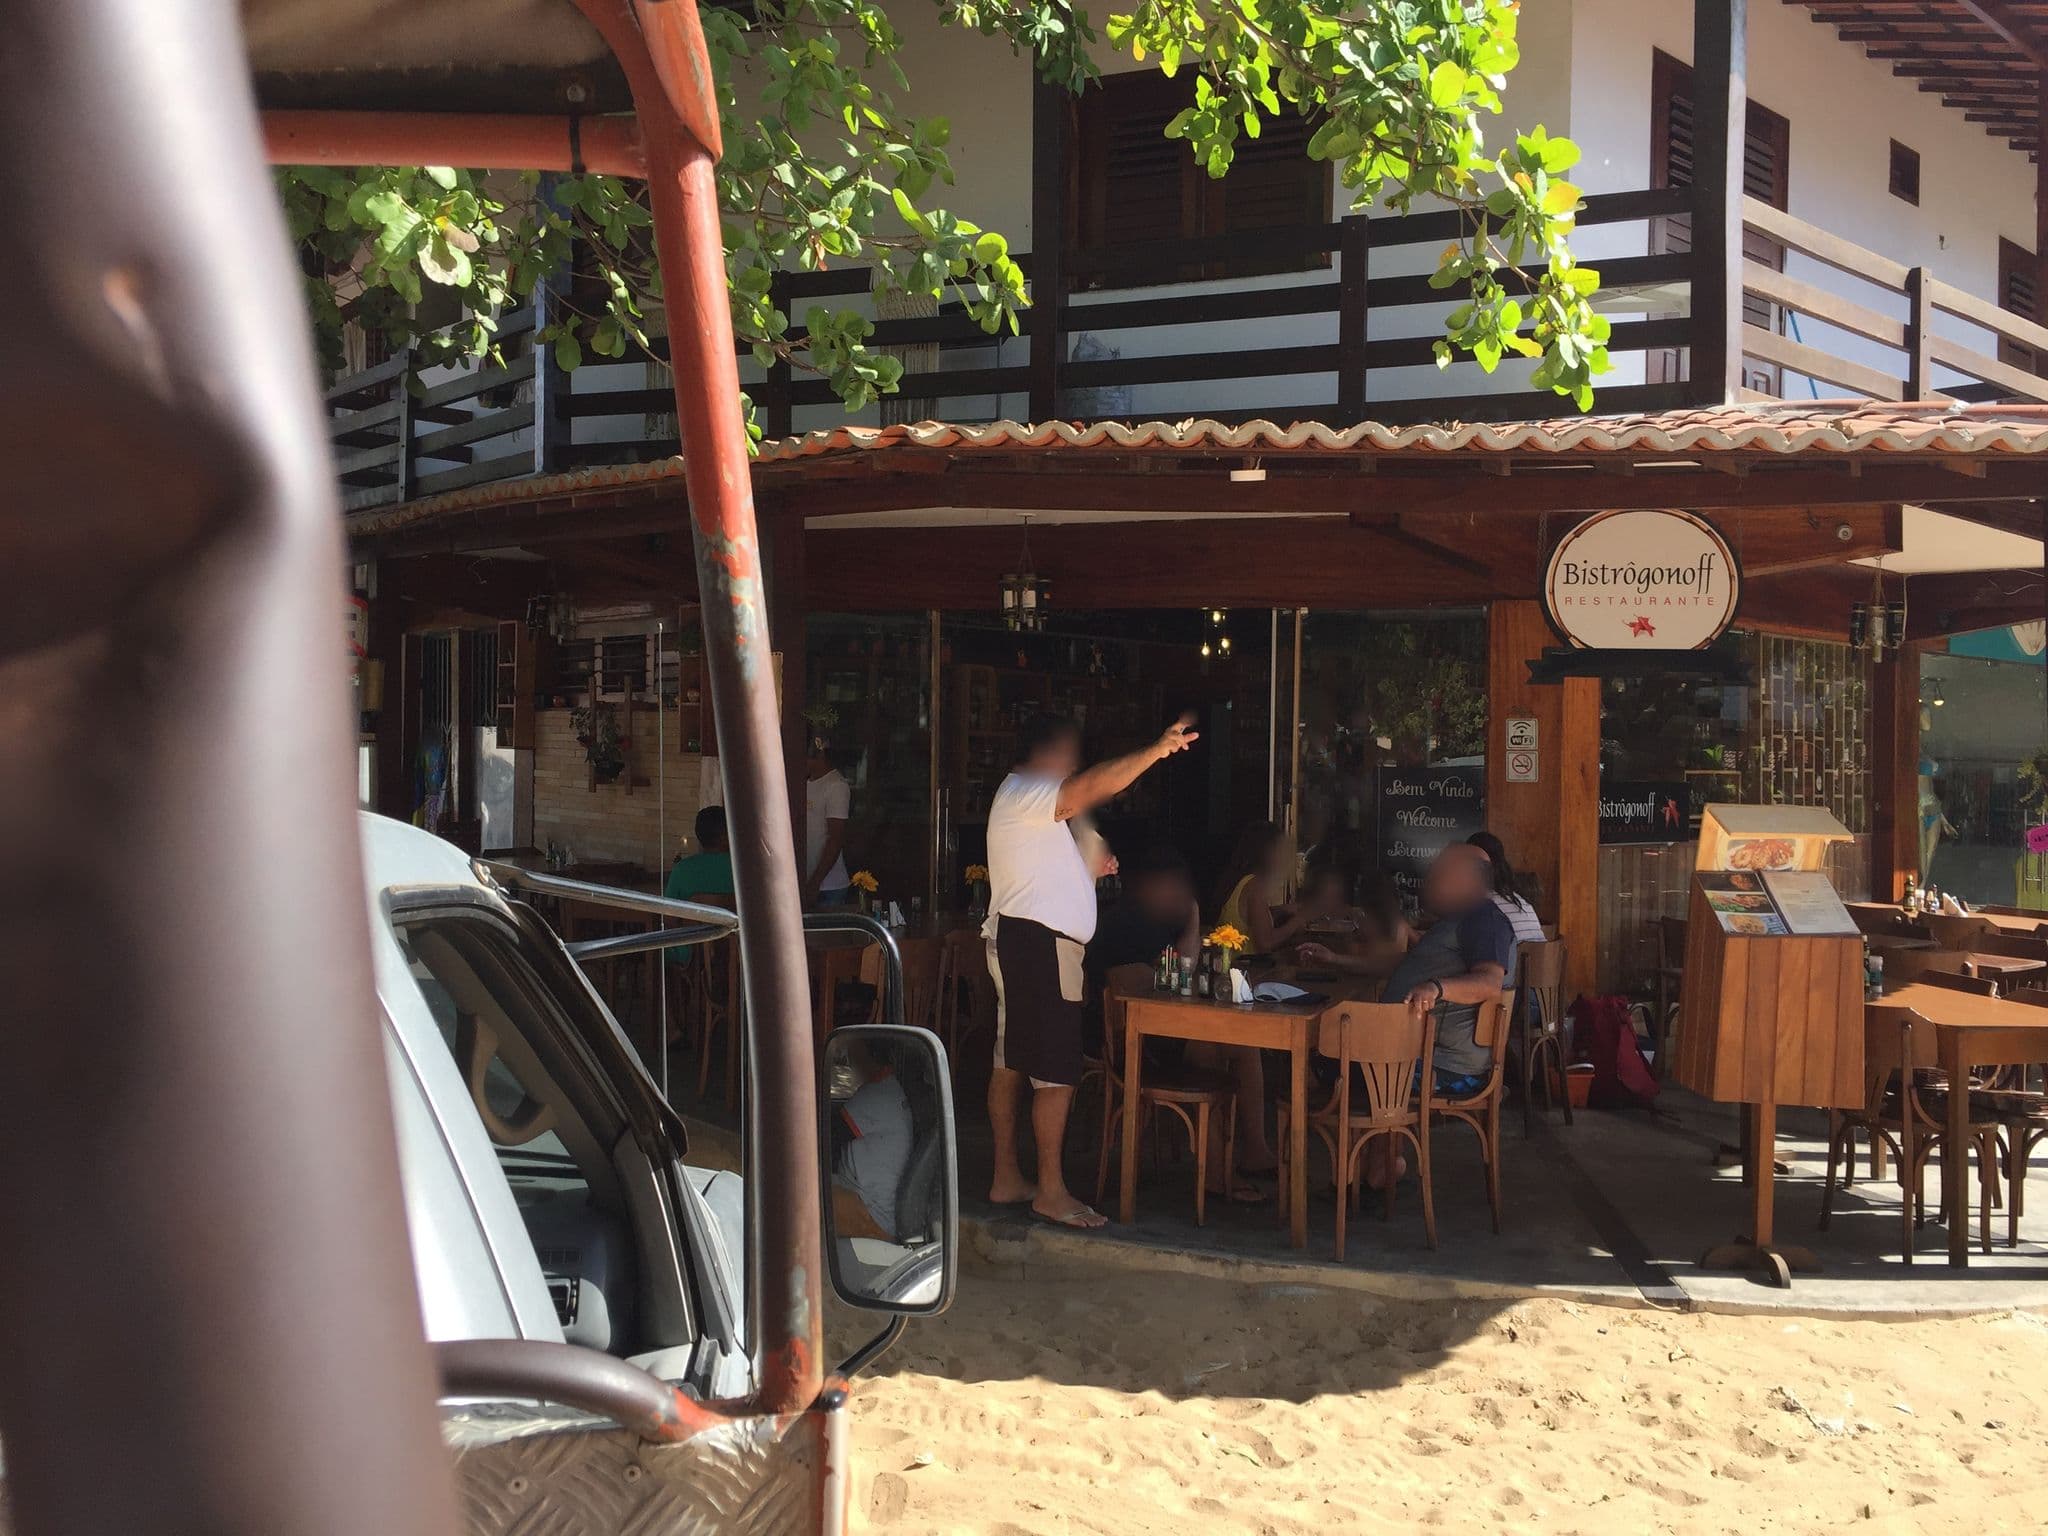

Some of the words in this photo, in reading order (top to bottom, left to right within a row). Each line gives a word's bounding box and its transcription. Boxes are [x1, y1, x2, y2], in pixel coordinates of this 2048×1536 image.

[1563, 553, 1716, 594] Bistrôgonoff
[1564, 596, 1715, 606] RESTAURANTE
[1385, 779, 1425, 797] Bem
[1429, 776, 1474, 799] Vindo
[1396, 805, 1457, 828] Welcome
